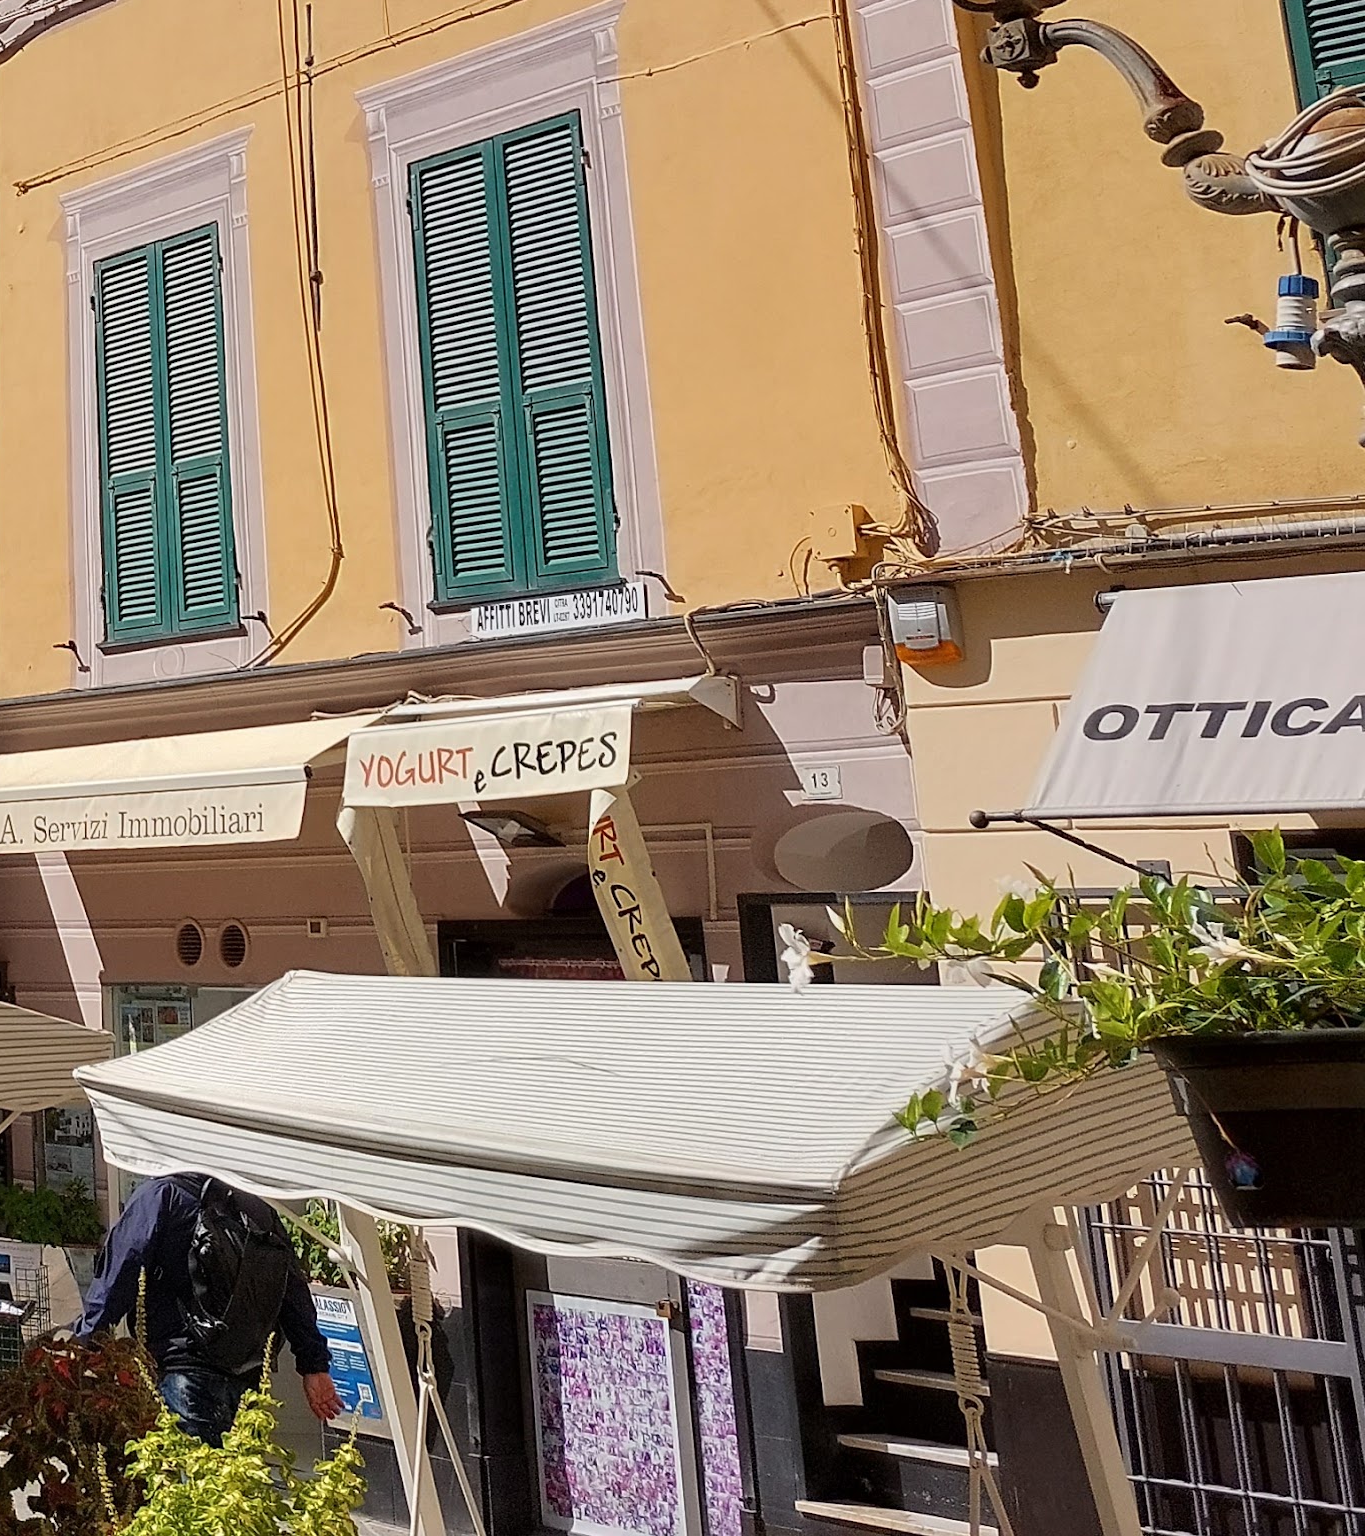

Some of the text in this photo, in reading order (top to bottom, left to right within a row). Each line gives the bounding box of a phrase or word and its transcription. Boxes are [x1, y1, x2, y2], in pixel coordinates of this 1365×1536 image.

[477, 586, 638, 632] AFFITTI BREVI 3391740790
[1083, 695, 1365, 741] OTTICA
[359, 731, 618, 794] YOGURT e CREPES
[811, 772, 829, 789] 13
[33, 812, 109, 844] Servizi
[117, 803, 265, 839] Immobiliari
[610, 884, 663, 982] CREP
